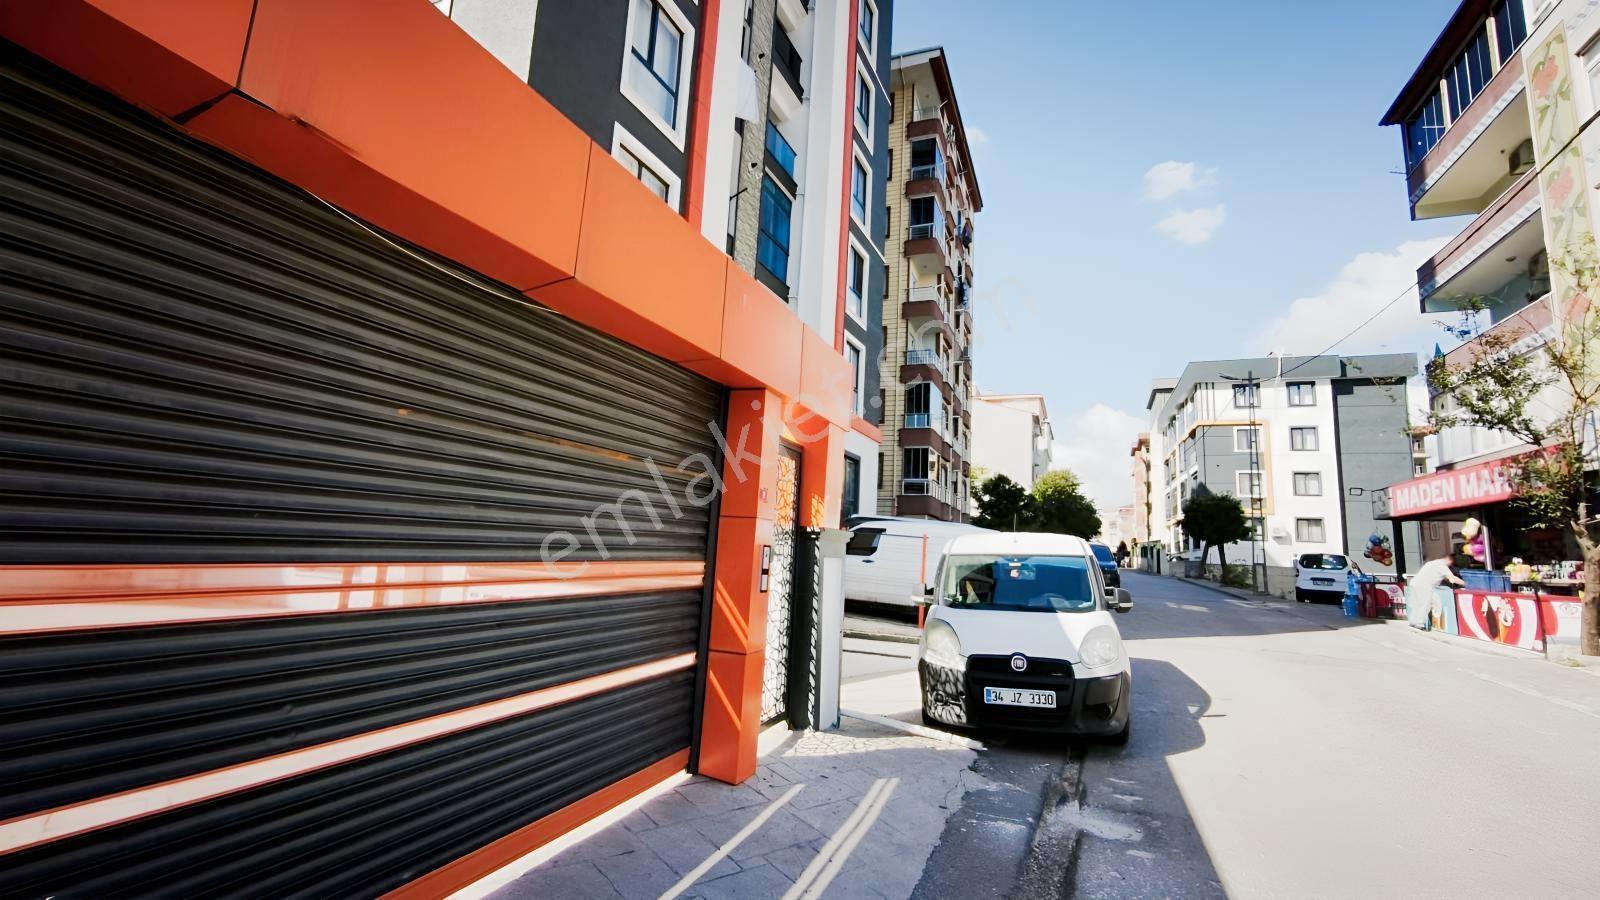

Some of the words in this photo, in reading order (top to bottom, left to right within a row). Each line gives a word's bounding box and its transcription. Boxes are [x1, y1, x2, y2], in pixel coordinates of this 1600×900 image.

[1396, 475, 1457, 511] MADEN
[1459, 461, 1523, 500] MAR
[991, 690, 1004, 702] 34
[1011, 692, 1022, 704] JZ
[1028, 693, 1054, 706] 3330
